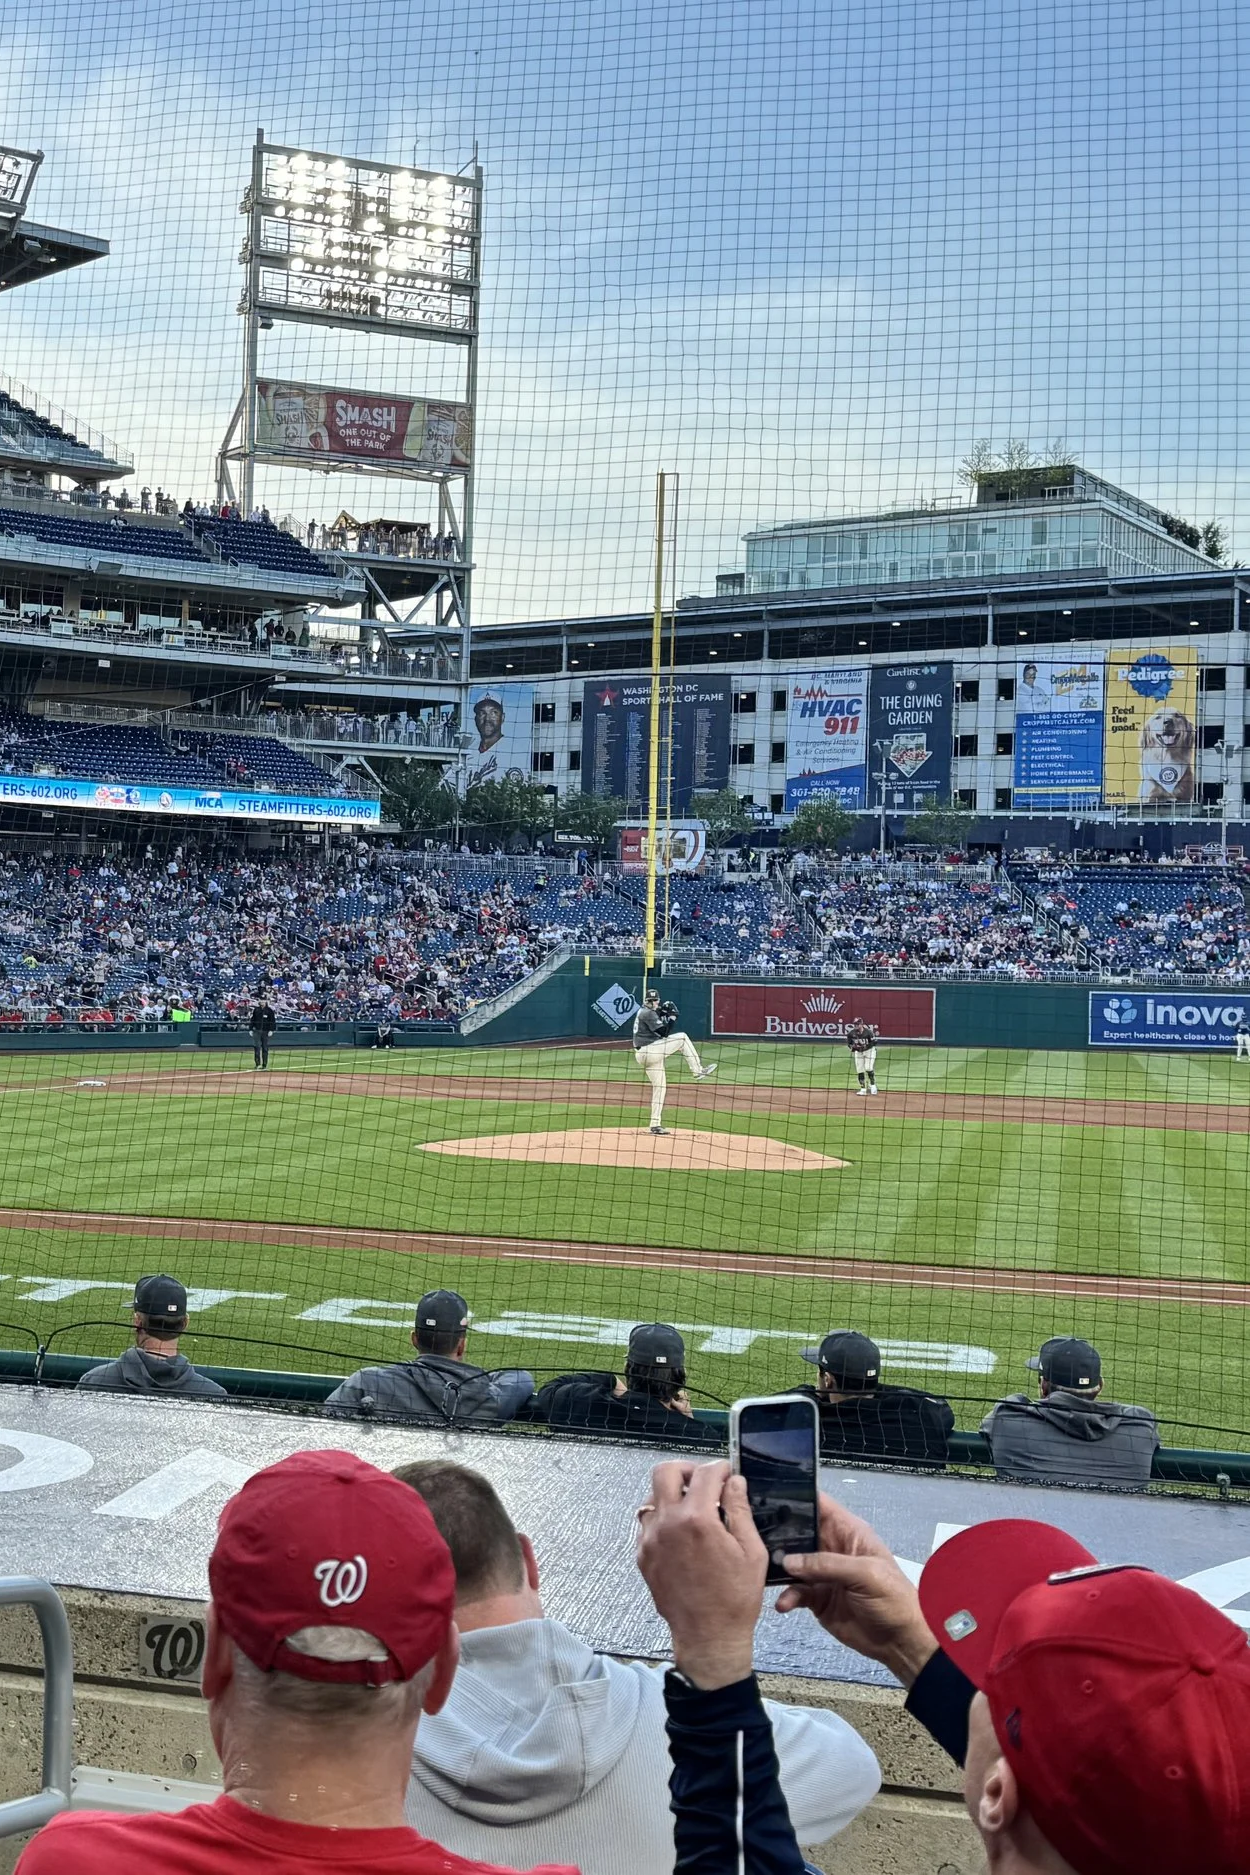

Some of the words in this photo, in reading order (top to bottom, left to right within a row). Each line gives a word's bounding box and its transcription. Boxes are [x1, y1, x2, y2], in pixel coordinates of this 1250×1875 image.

[335, 399, 396, 433] SMASH
[339, 428, 357, 437] ONE
[360, 429, 377, 439] OUT
[379, 432, 391, 442] OF
[345, 438, 362, 447] THE
[364, 439, 386, 451] PARK
[1117, 667, 1185, 684] Pedigree
[623, 685, 683, 695] WASHIGTON
[685, 684, 699, 692] DC
[659, 695, 682, 704] HALL
[684, 694, 697, 703] OF
[699, 693, 724, 702] FAME
[879, 696, 901, 710] THE
[903, 694, 943, 709] GIVING
[800, 698, 863, 719] HVAC
[1111, 705, 1135, 715] Feed
[824, 716, 860, 736] 911
[888, 711, 933, 726] GARDEN
[1111, 715, 1128, 724] the
[790, 786, 860, 797] 301-820-7848
[195, 796, 223, 809] MCA
[238, 799, 372, 818] STEAMFITTERS-602.ORG
[613, 995, 635, 1014] W
[1146, 998, 1245, 1026] Inova
[1103, 1030, 1131, 1039] Expert
[1134, 1031, 1182, 1041] healthcare,
[1183, 1033, 1206, 1041] close
[1208, 1033, 1217, 1041] to
[313, 1554, 368, 1608] W
[145, 1619, 205, 1679] W
